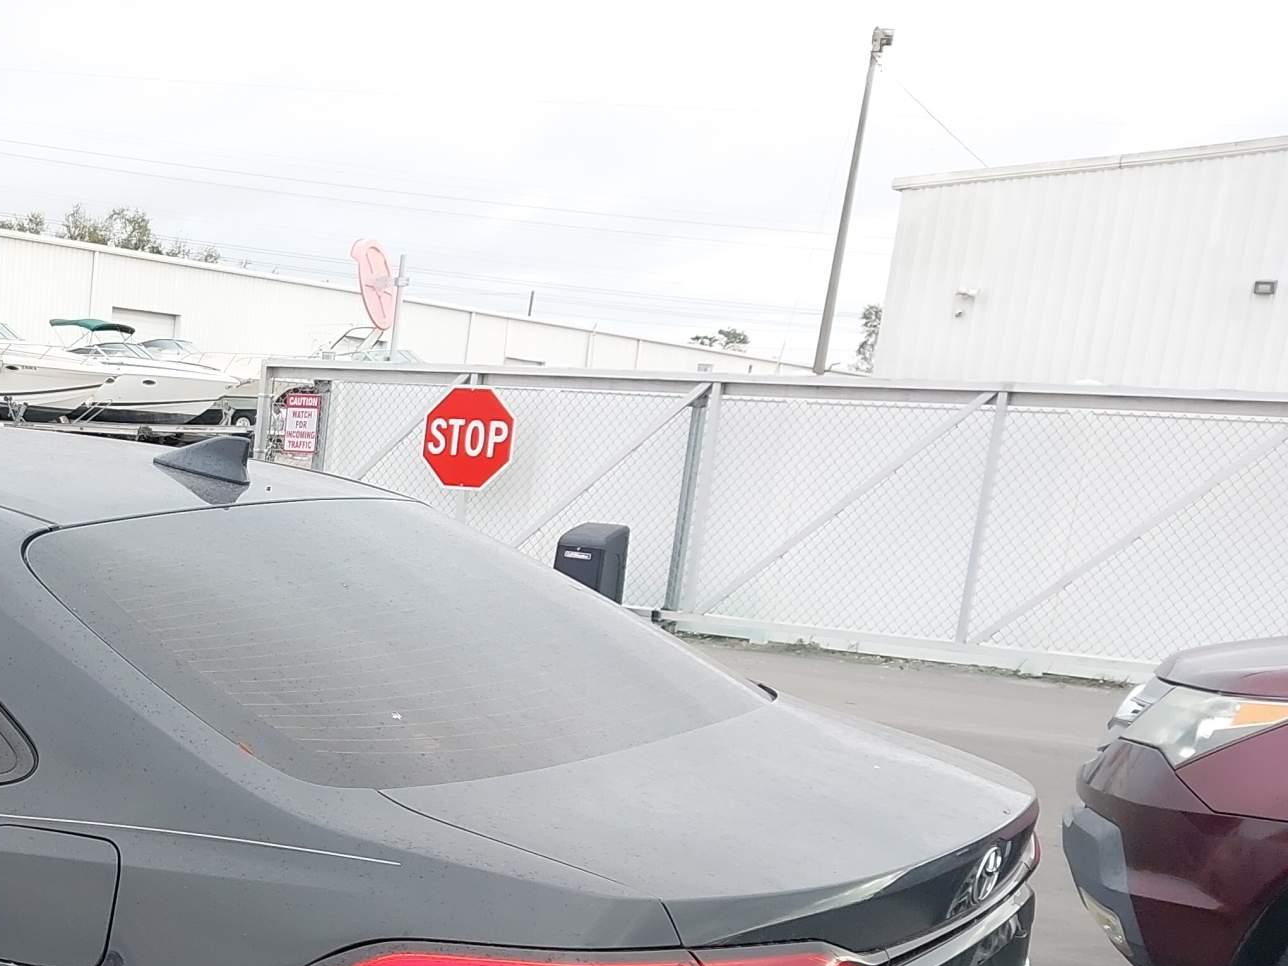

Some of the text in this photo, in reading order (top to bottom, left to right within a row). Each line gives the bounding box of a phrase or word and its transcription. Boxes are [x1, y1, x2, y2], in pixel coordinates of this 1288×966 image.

[288, 396, 318, 407] CAUTION
[292, 411, 312, 419] WATCH
[286, 431, 315, 440] INCOMING
[428, 418, 508, 458] STOP
[288, 440, 312, 449] TRAFFIC
